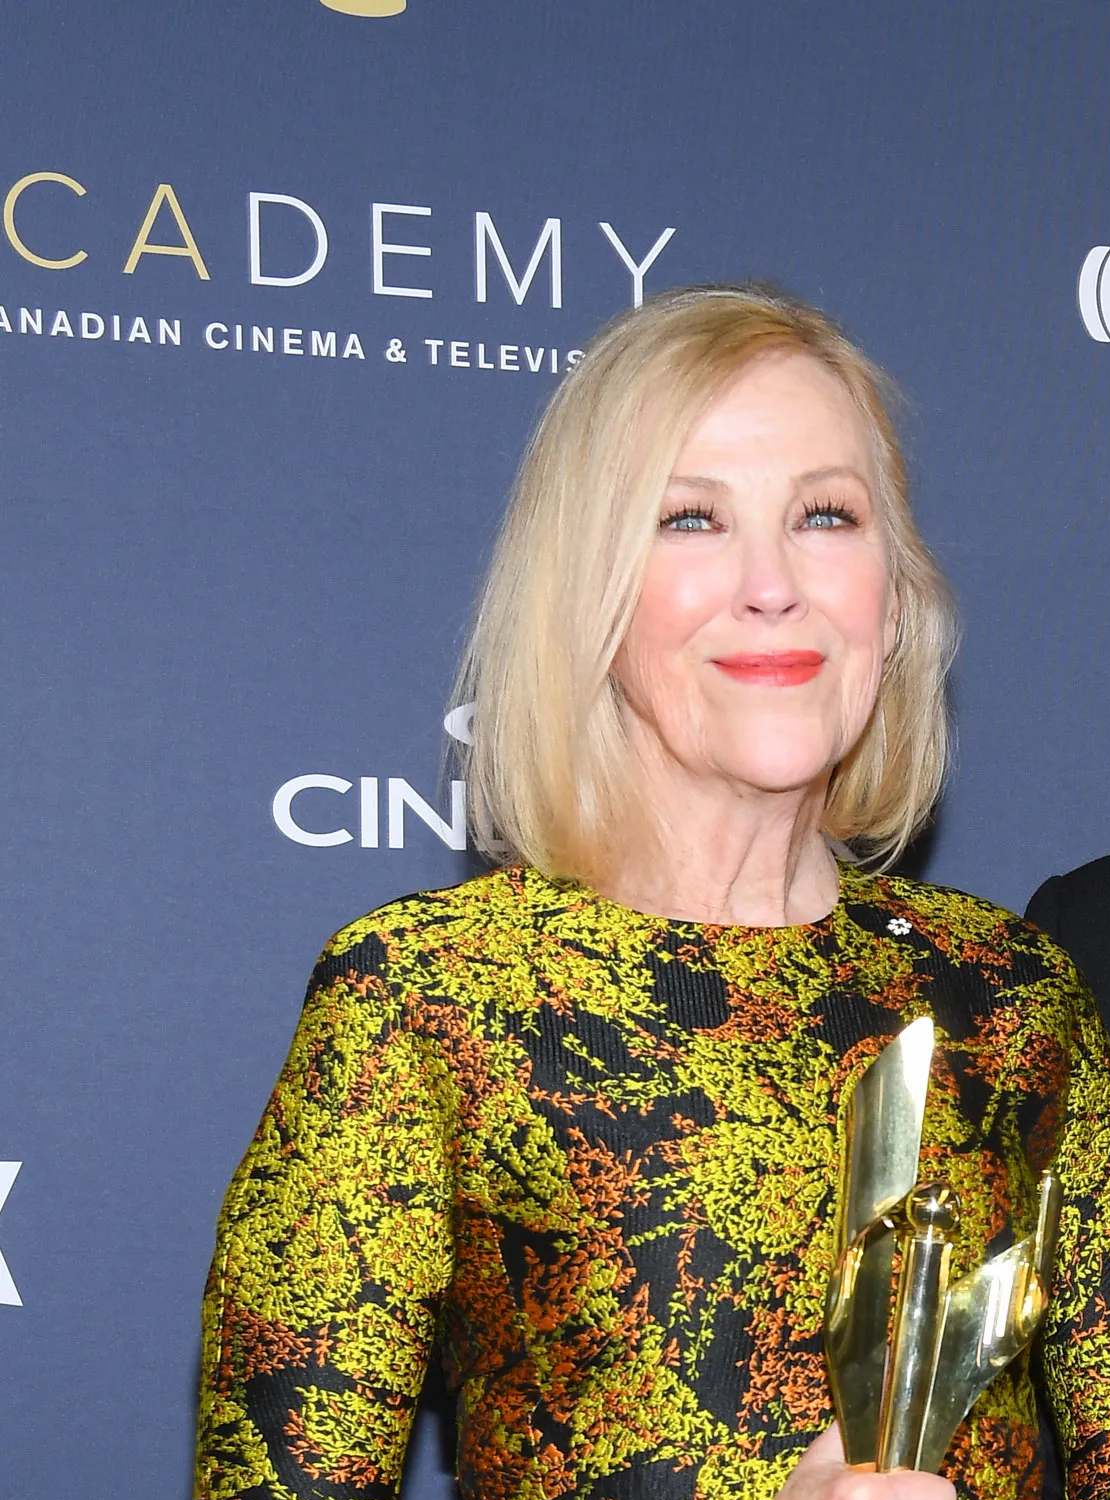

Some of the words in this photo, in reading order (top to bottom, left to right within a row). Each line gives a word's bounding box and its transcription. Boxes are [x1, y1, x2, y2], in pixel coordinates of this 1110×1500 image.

[205, 321, 365, 360] CINEMA
[385, 337, 407, 363] &
[272, 773, 506, 851] CIN
